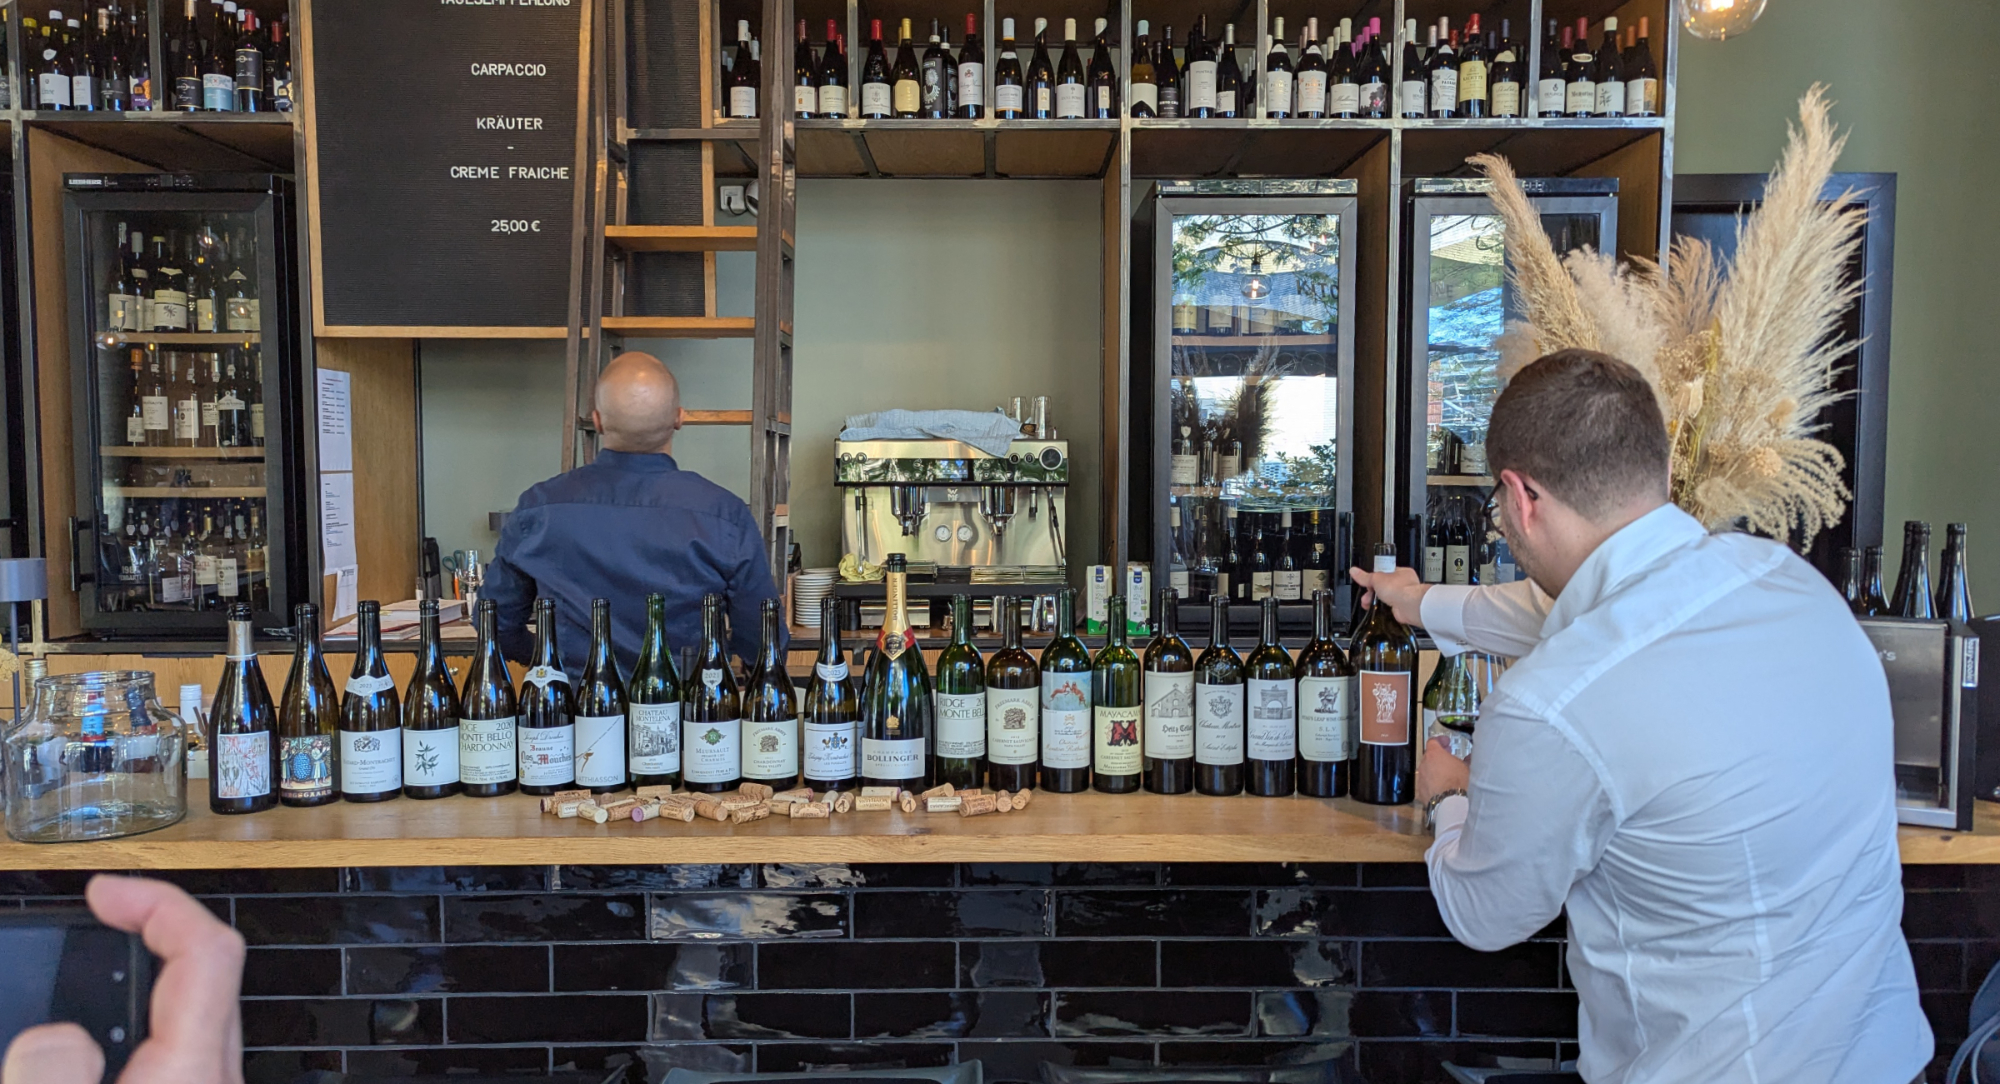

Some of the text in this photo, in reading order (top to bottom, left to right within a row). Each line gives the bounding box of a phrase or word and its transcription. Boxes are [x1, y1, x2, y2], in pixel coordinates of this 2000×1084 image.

[471, 63, 546, 76] CARPACCIO
[477, 115, 543, 130] KRÄUTER
[450, 166, 569, 180] CREME FRAICHE
[491, 220, 540, 235] 25,00 €
[940, 698, 965, 708] RIDGE
[940, 709, 970, 718] MONTE
[496, 721, 514, 731] 2020
[486, 730, 513, 742] BELLO
[866, 754, 919, 762] BOLLINGER
